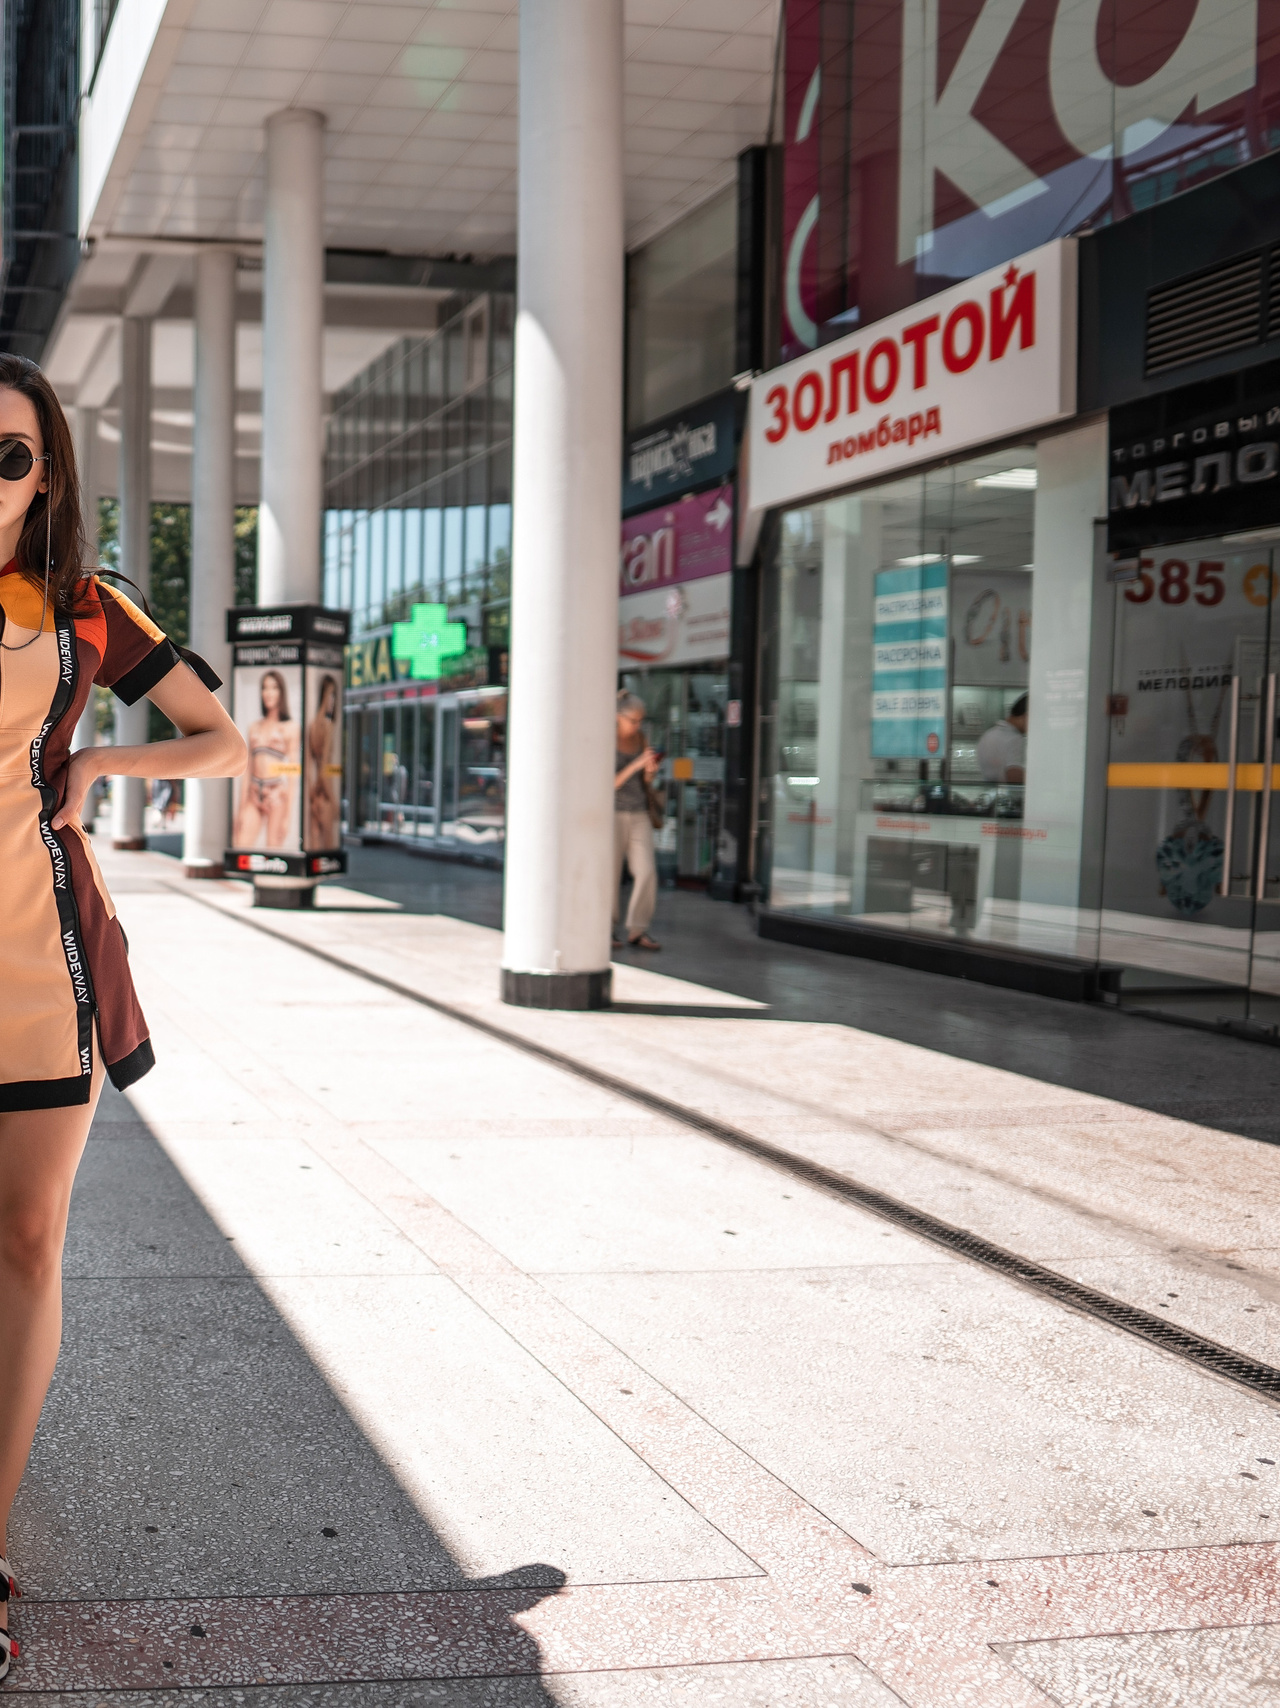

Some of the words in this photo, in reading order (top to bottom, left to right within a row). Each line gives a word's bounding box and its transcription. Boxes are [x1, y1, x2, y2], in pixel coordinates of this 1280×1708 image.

[764, 262, 1036, 444] ЗОЛОТОЙ
[827, 404, 942, 466] ломбард
[1124, 558, 1225, 606] 585
[58, 629, 73, 685] WIDEWAY
[1137, 674, 1233, 692] МЕЛОДИЯ
[31, 722, 53, 788] WIDEWAY
[41, 820, 66, 889] WIDEWAY
[62, 930, 90, 1004] WIDEWAY
